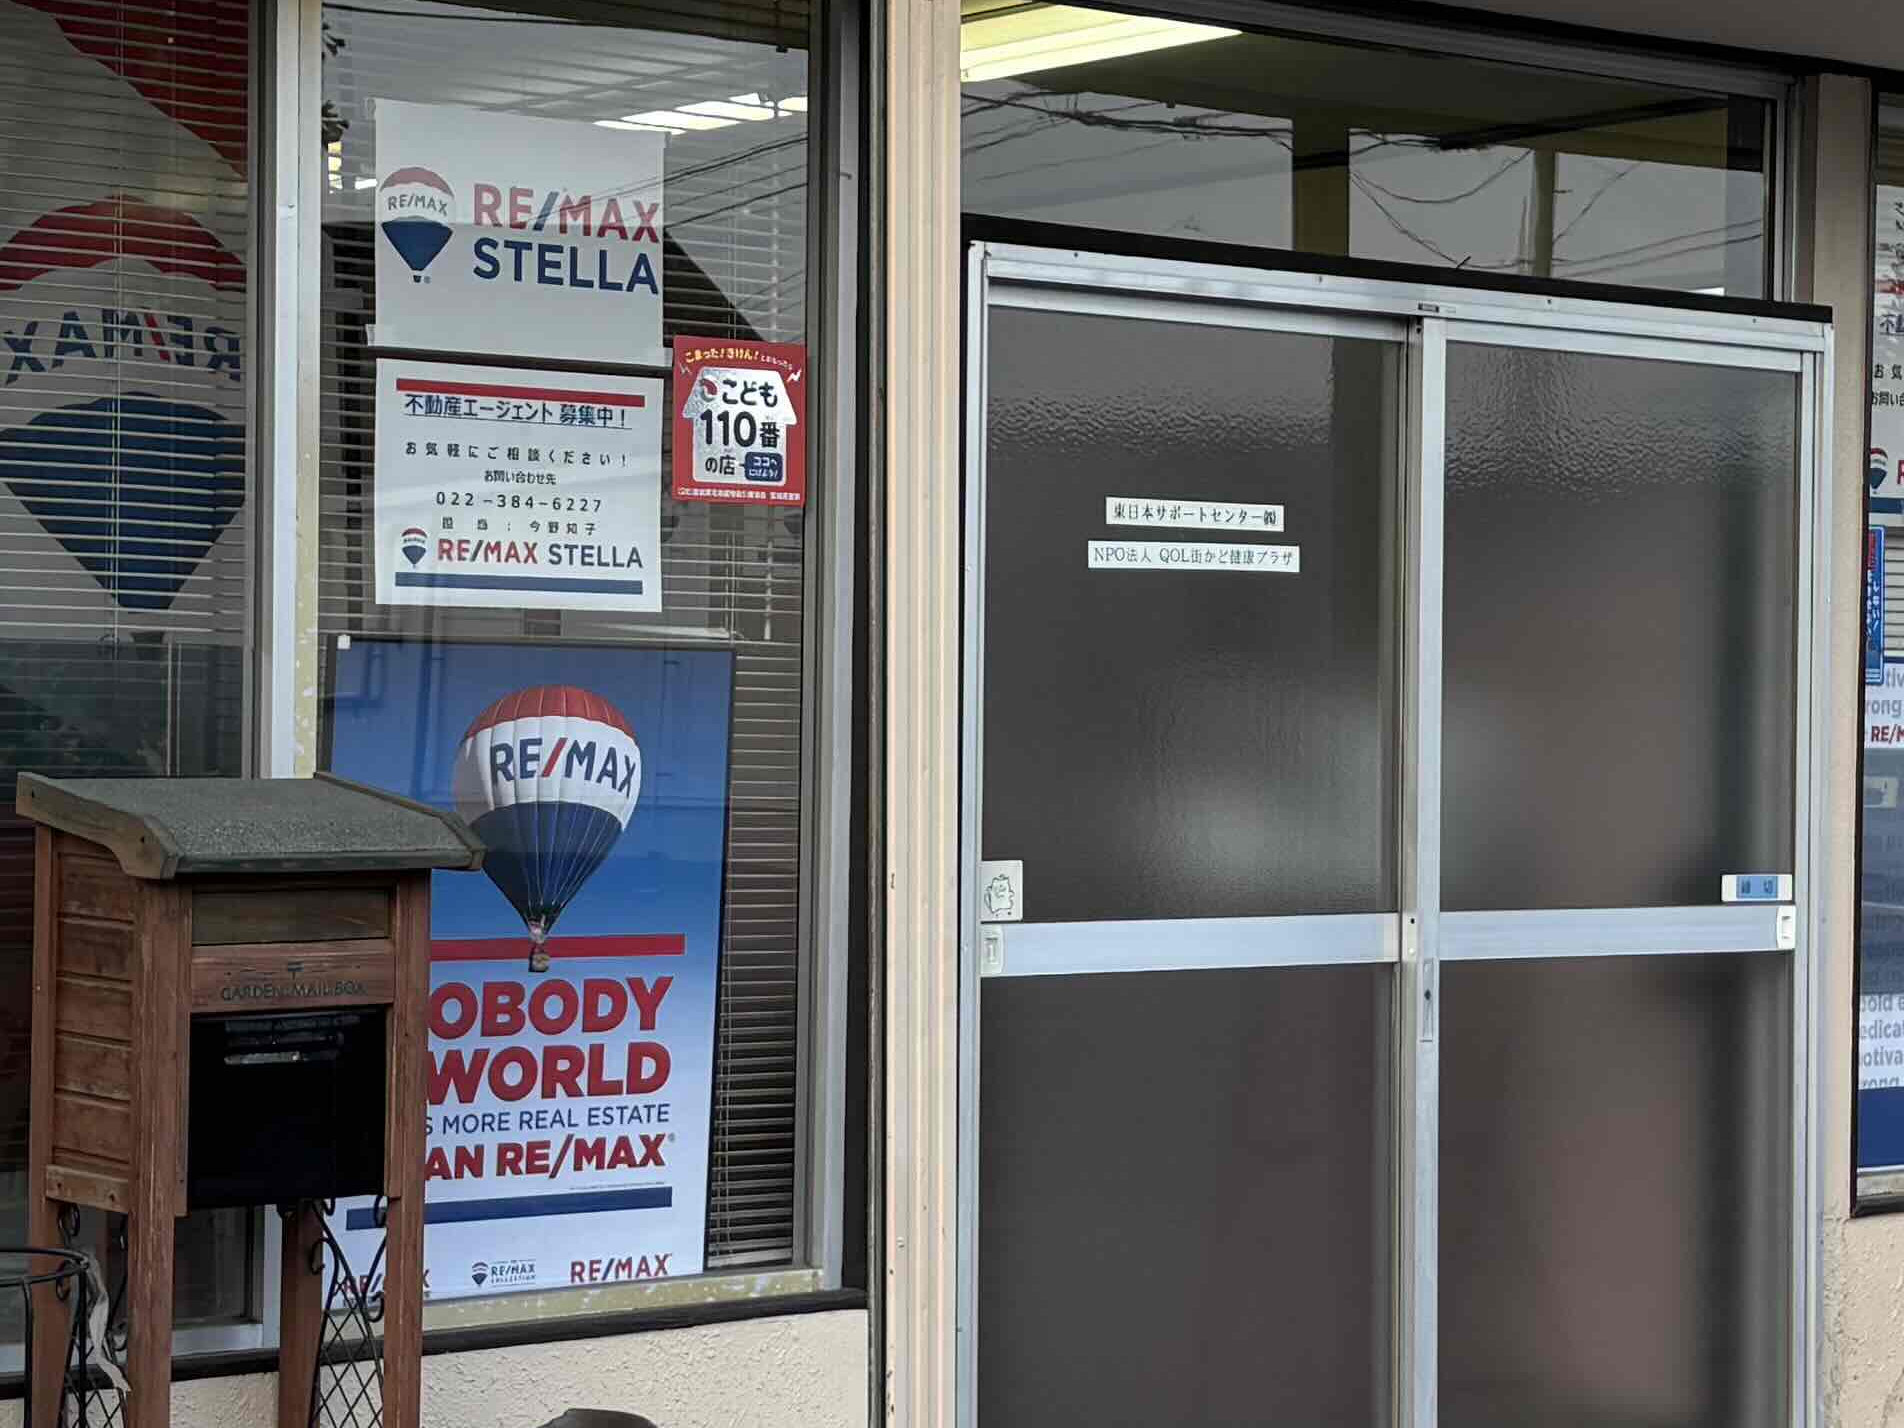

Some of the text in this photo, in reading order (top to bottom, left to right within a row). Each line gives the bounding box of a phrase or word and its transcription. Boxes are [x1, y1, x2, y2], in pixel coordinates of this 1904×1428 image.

[388, 194, 448, 216] RE/MAX
[473, 183, 660, 244] RE/MAX
[473, 237, 659, 295] STELLA
[722, 379, 778, 407] こども
[483, 470, 557, 485] お問い合わせ先
[437, 538, 643, 569] RE/MAX STELLA
[490, 737, 637, 799] RE/MAX
[428, 975, 674, 1040] OBODY
[428, 1041, 672, 1106] WORLD
[442, 1112, 511, 1135] MORE
[519, 1108, 580, 1131] REAL
[588, 1103, 671, 1126] ESTATE
[426, 1132, 667, 1181] AN RE/MAX
[491, 1262, 536, 1277] RE/MAX
[570, 1253, 669, 1284] RE/MAX
